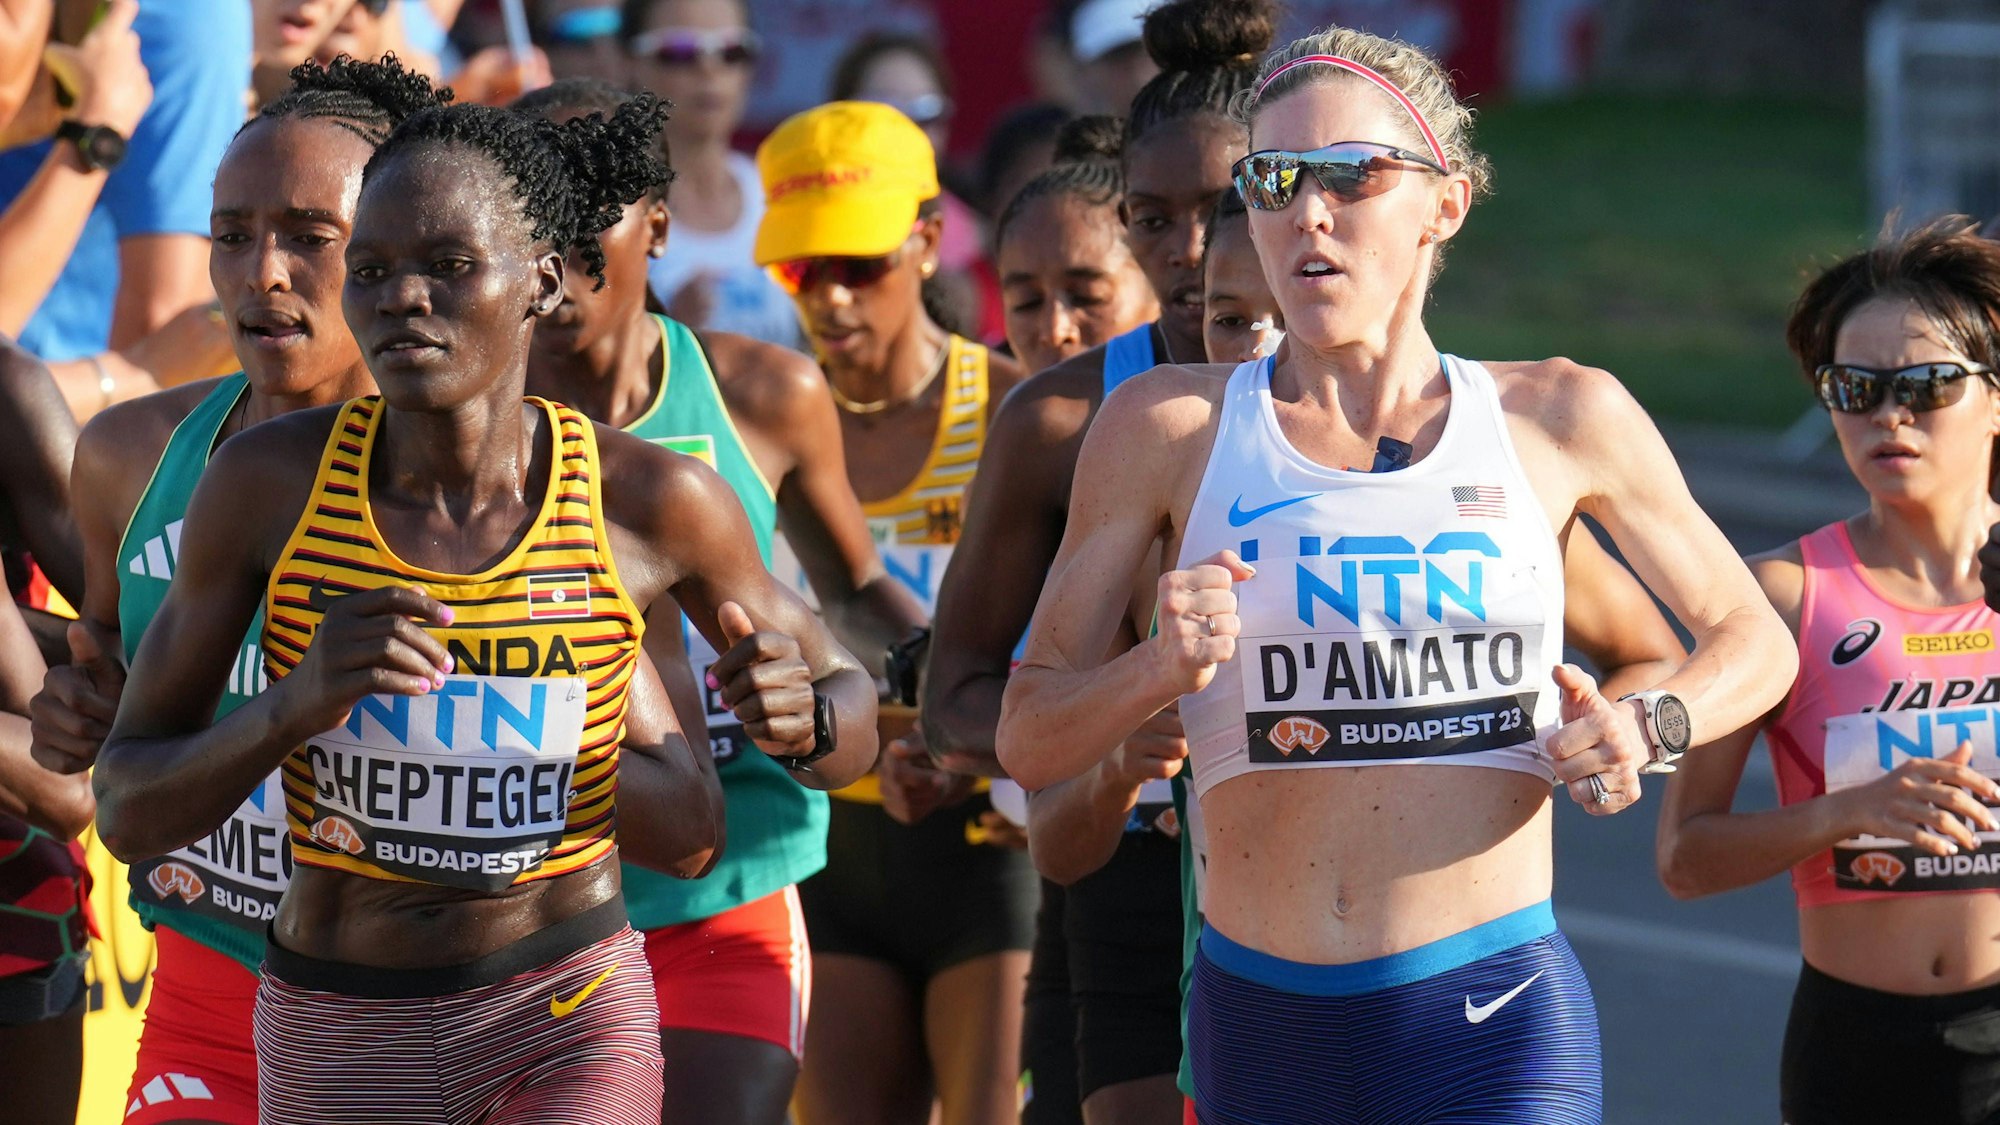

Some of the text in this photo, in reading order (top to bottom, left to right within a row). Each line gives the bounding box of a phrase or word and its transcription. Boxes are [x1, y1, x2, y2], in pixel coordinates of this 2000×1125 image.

[1296, 559, 1486, 628] NTN
[1260, 632, 1523, 702] D'AMATO
[1906, 632, 1990, 653] SEIKO
[346, 681, 547, 752] NTN
[1340, 707, 1522, 745] BUDAPEST 23
[376, 841, 537, 875] BUDAPEST
